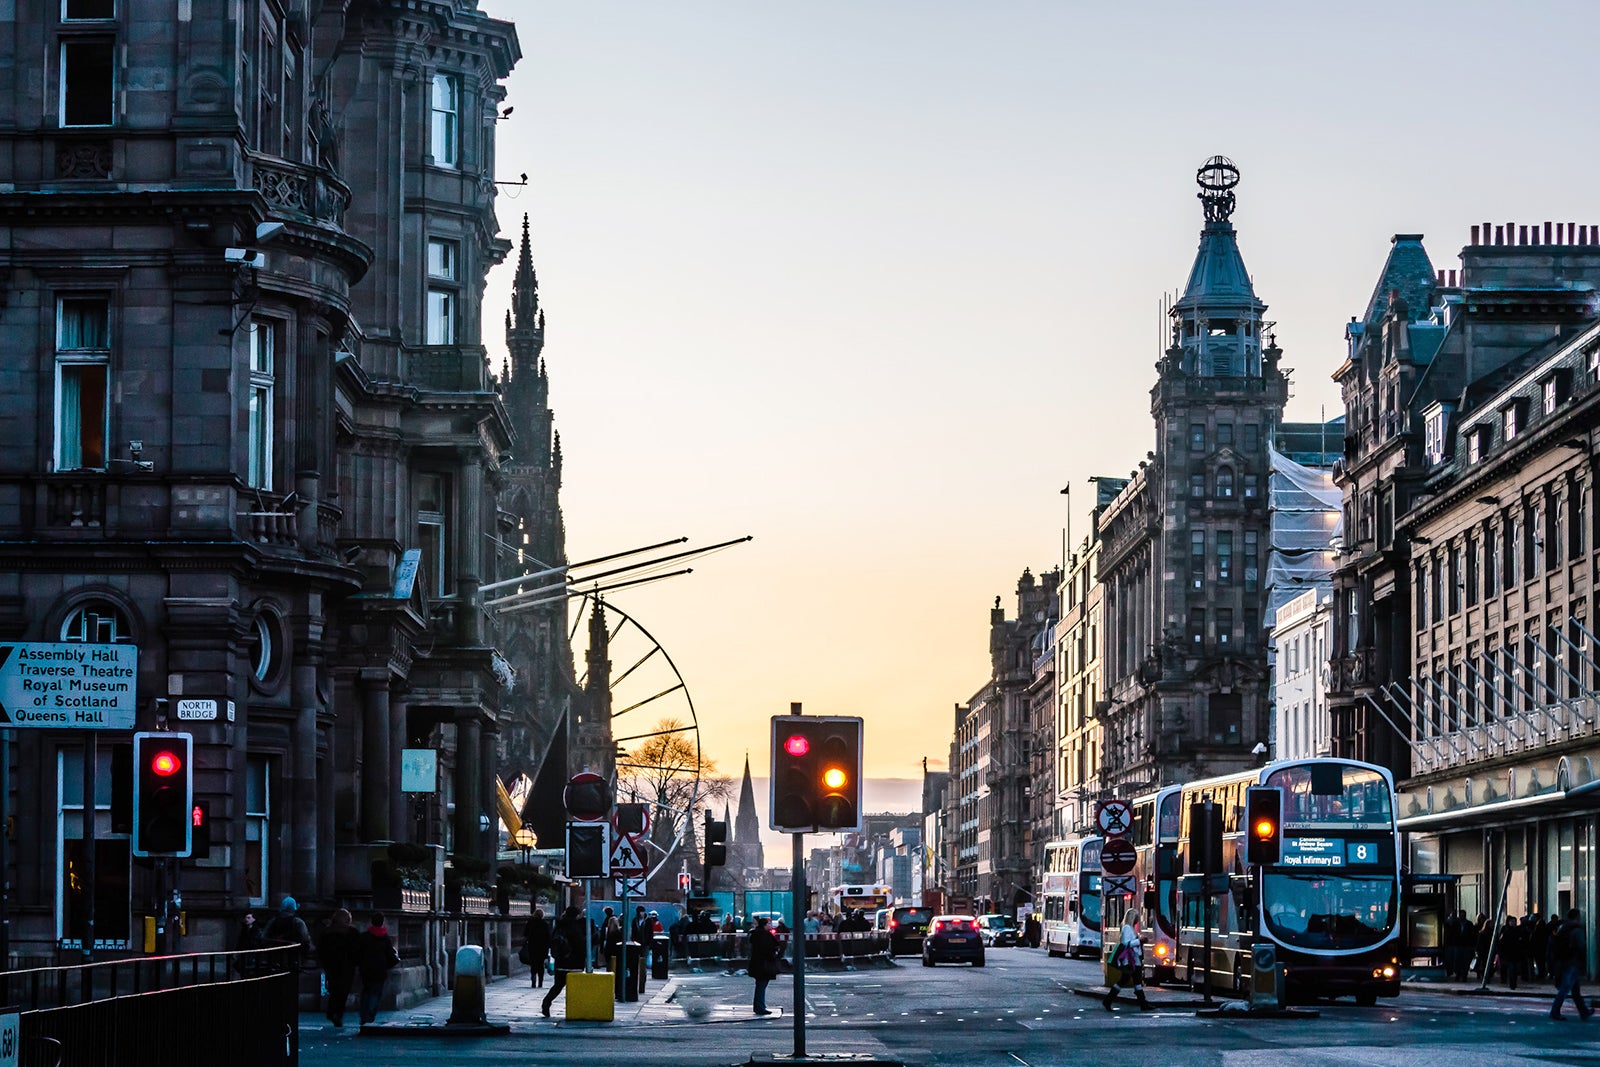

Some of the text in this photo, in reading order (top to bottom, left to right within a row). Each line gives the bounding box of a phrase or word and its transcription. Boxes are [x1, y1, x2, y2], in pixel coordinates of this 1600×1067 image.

[19, 648, 119, 662] Assembly Hall
[19, 664, 133, 677] Traverse Theatre
[24, 680, 128, 692] Royal Museum
[34, 695, 118, 707] of Scotland
[16, 710, 103, 722] Queens Hall
[1357, 846, 1366, 860] 8
[1284, 856, 1302, 865] Royal
[1303, 856, 1332, 866] Infirmary
[0, 1025, 16, 1059] 68)
